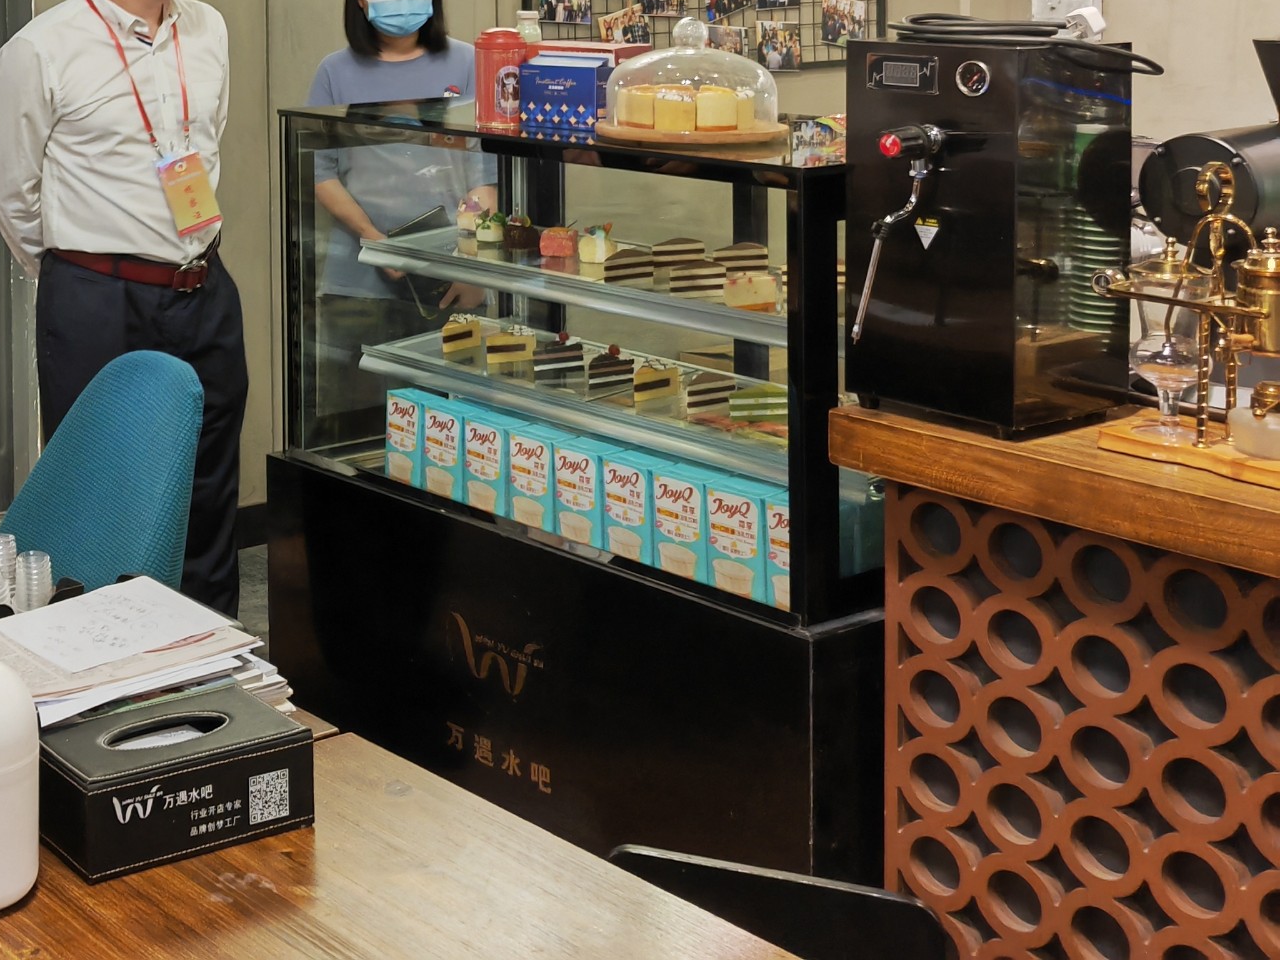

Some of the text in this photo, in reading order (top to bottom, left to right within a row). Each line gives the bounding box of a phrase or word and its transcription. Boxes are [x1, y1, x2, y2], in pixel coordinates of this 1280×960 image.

[389, 401, 416, 419] JoyQ
[427, 415, 455, 433] JoyQ
[467, 427, 497, 445] JoyQ
[511, 442, 545, 460] JoyQ
[556, 455, 590, 474] JoyQ
[605, 468, 640, 488] JoyQ
[656, 483, 694, 504] JoyQ
[709, 498, 751, 519] JoyQ
[446, 720, 553, 795] 万遇水吧
[162, 784, 214, 810] 万遇水吧
[190, 799, 243, 821] 行业开店专家
